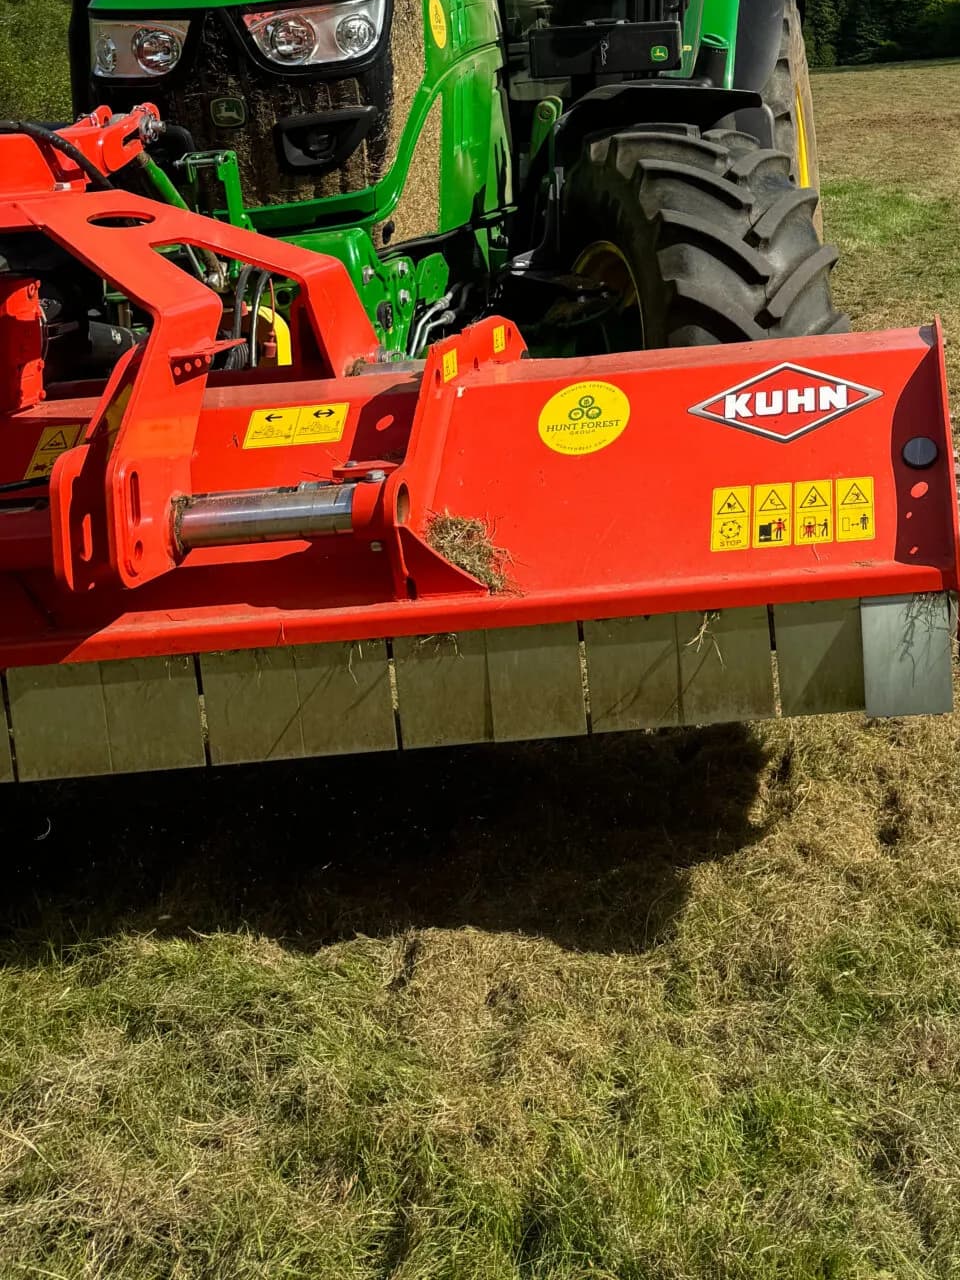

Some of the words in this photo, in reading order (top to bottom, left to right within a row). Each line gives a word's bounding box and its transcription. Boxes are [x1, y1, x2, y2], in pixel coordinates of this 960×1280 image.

[724, 384, 848, 420] KUHN
[546, 423, 579, 432] HUNT
[581, 419, 621, 429] FOREST
[719, 539, 742, 547] STOP
